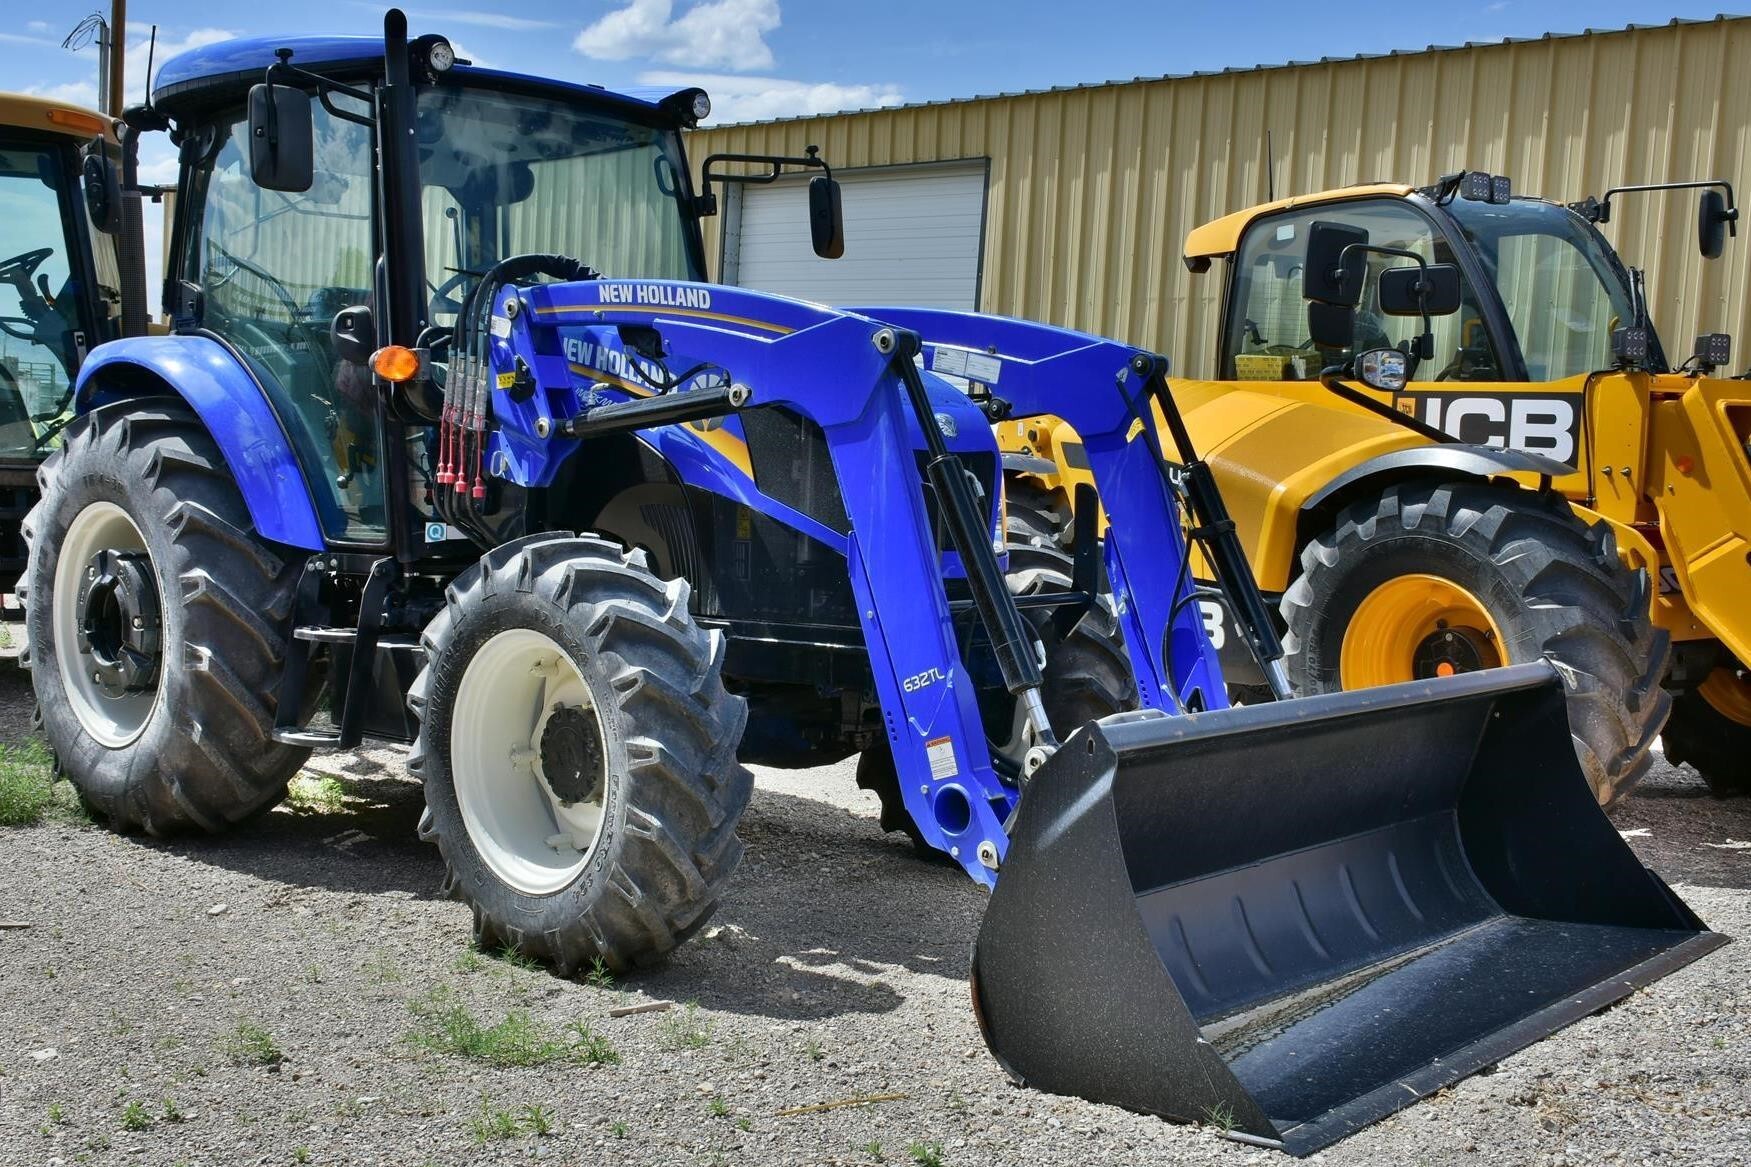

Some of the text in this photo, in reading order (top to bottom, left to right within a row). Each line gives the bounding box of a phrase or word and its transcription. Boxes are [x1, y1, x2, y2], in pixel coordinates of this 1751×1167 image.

[599, 284, 711, 309] NEW HOLLAND
[903, 667, 945, 692] 632TL
